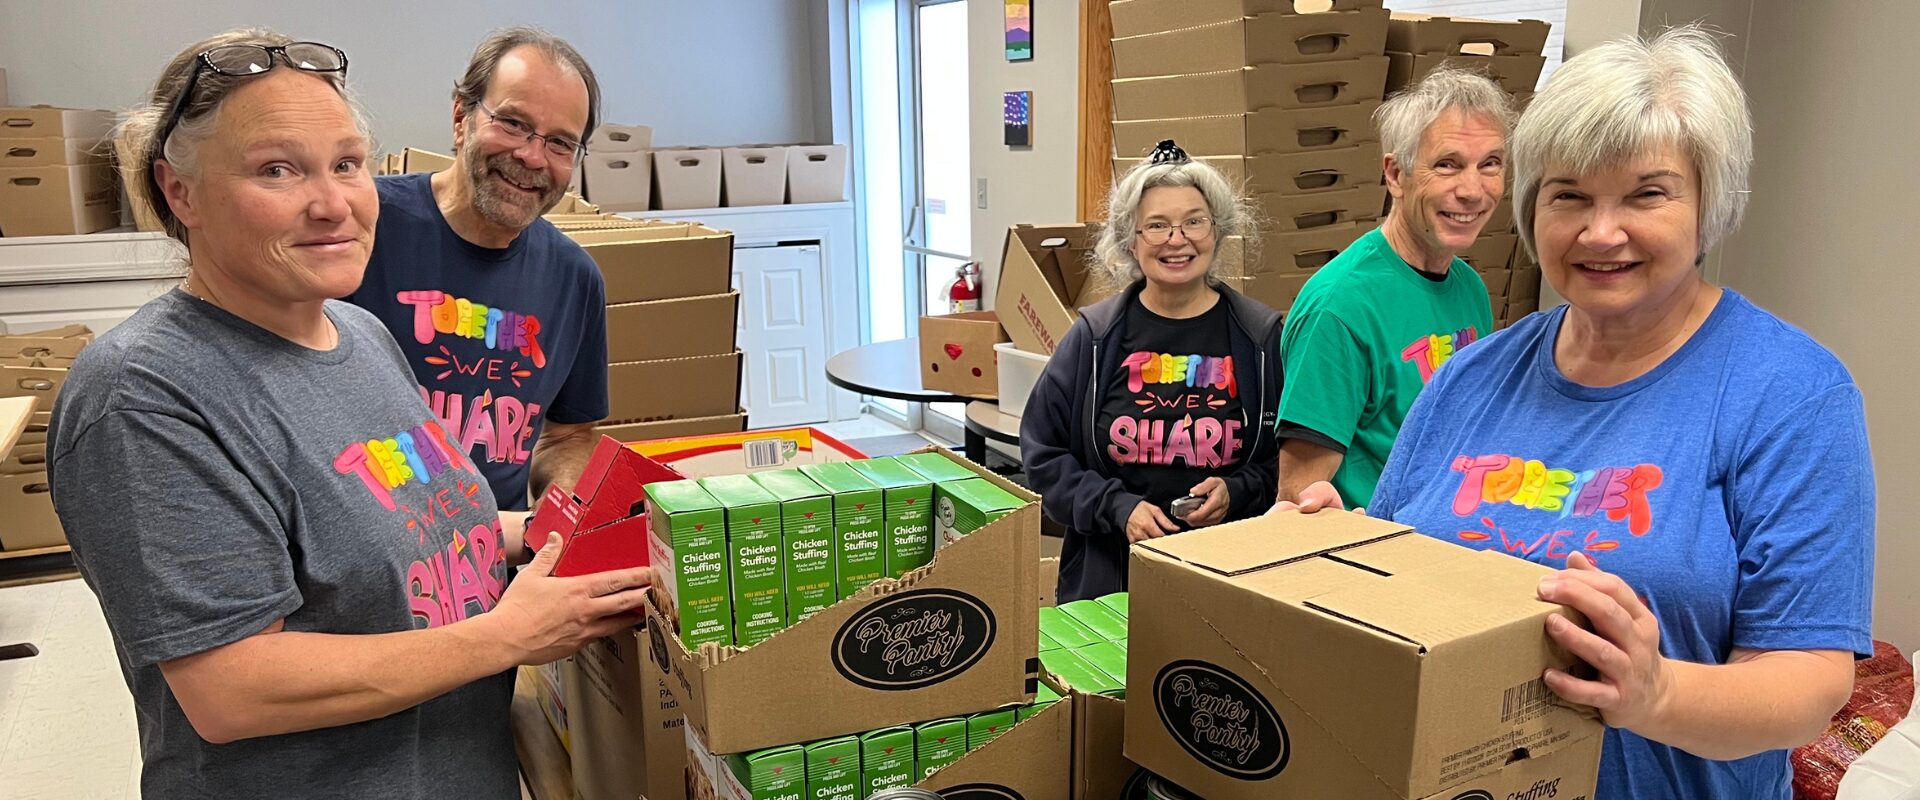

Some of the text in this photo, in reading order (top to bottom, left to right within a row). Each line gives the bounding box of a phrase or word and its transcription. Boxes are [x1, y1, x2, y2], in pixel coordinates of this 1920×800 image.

[397, 290, 547, 368] TOGETHER
[1018, 292, 1057, 354] FAREWA
[453, 355, 503, 380] WE
[1120, 351, 1237, 399] TOGETHER
[1157, 394, 1200, 409] WE
[1107, 414, 1243, 468] SHARE
[1452, 454, 1664, 537] TOGETHER
[421, 488, 461, 527] WE
[844, 530, 878, 541] Chicken
[894, 524, 928, 536] Chicken
[792, 539, 828, 550] Chicken
[844, 540, 879, 552] Stuffing
[894, 534, 928, 546] Stuffing
[1499, 528, 1575, 559] WE
[682, 552, 720, 563] Chicken
[740, 545, 776, 557] Chicken
[793, 549, 828, 561] Stuffing
[740, 555, 777, 567] Stuffing
[683, 562, 721, 575] Stuffing
[746, 616, 779, 628] INSTRUCTIONS
[752, 611, 773, 620] COOKING
[691, 625, 725, 636] INSTRUCTIONS
[696, 619, 718, 629] COOKING
[856, 609, 952, 653] Premier
[882, 622, 965, 675] Pantry
[1172, 674, 1249, 722] Premier
[1190, 710, 1260, 764] Pantry
[872, 773, 908, 787] Chicken
[816, 783, 854, 798] Chicken
[1506, 777, 1561, 800] Stuffing
